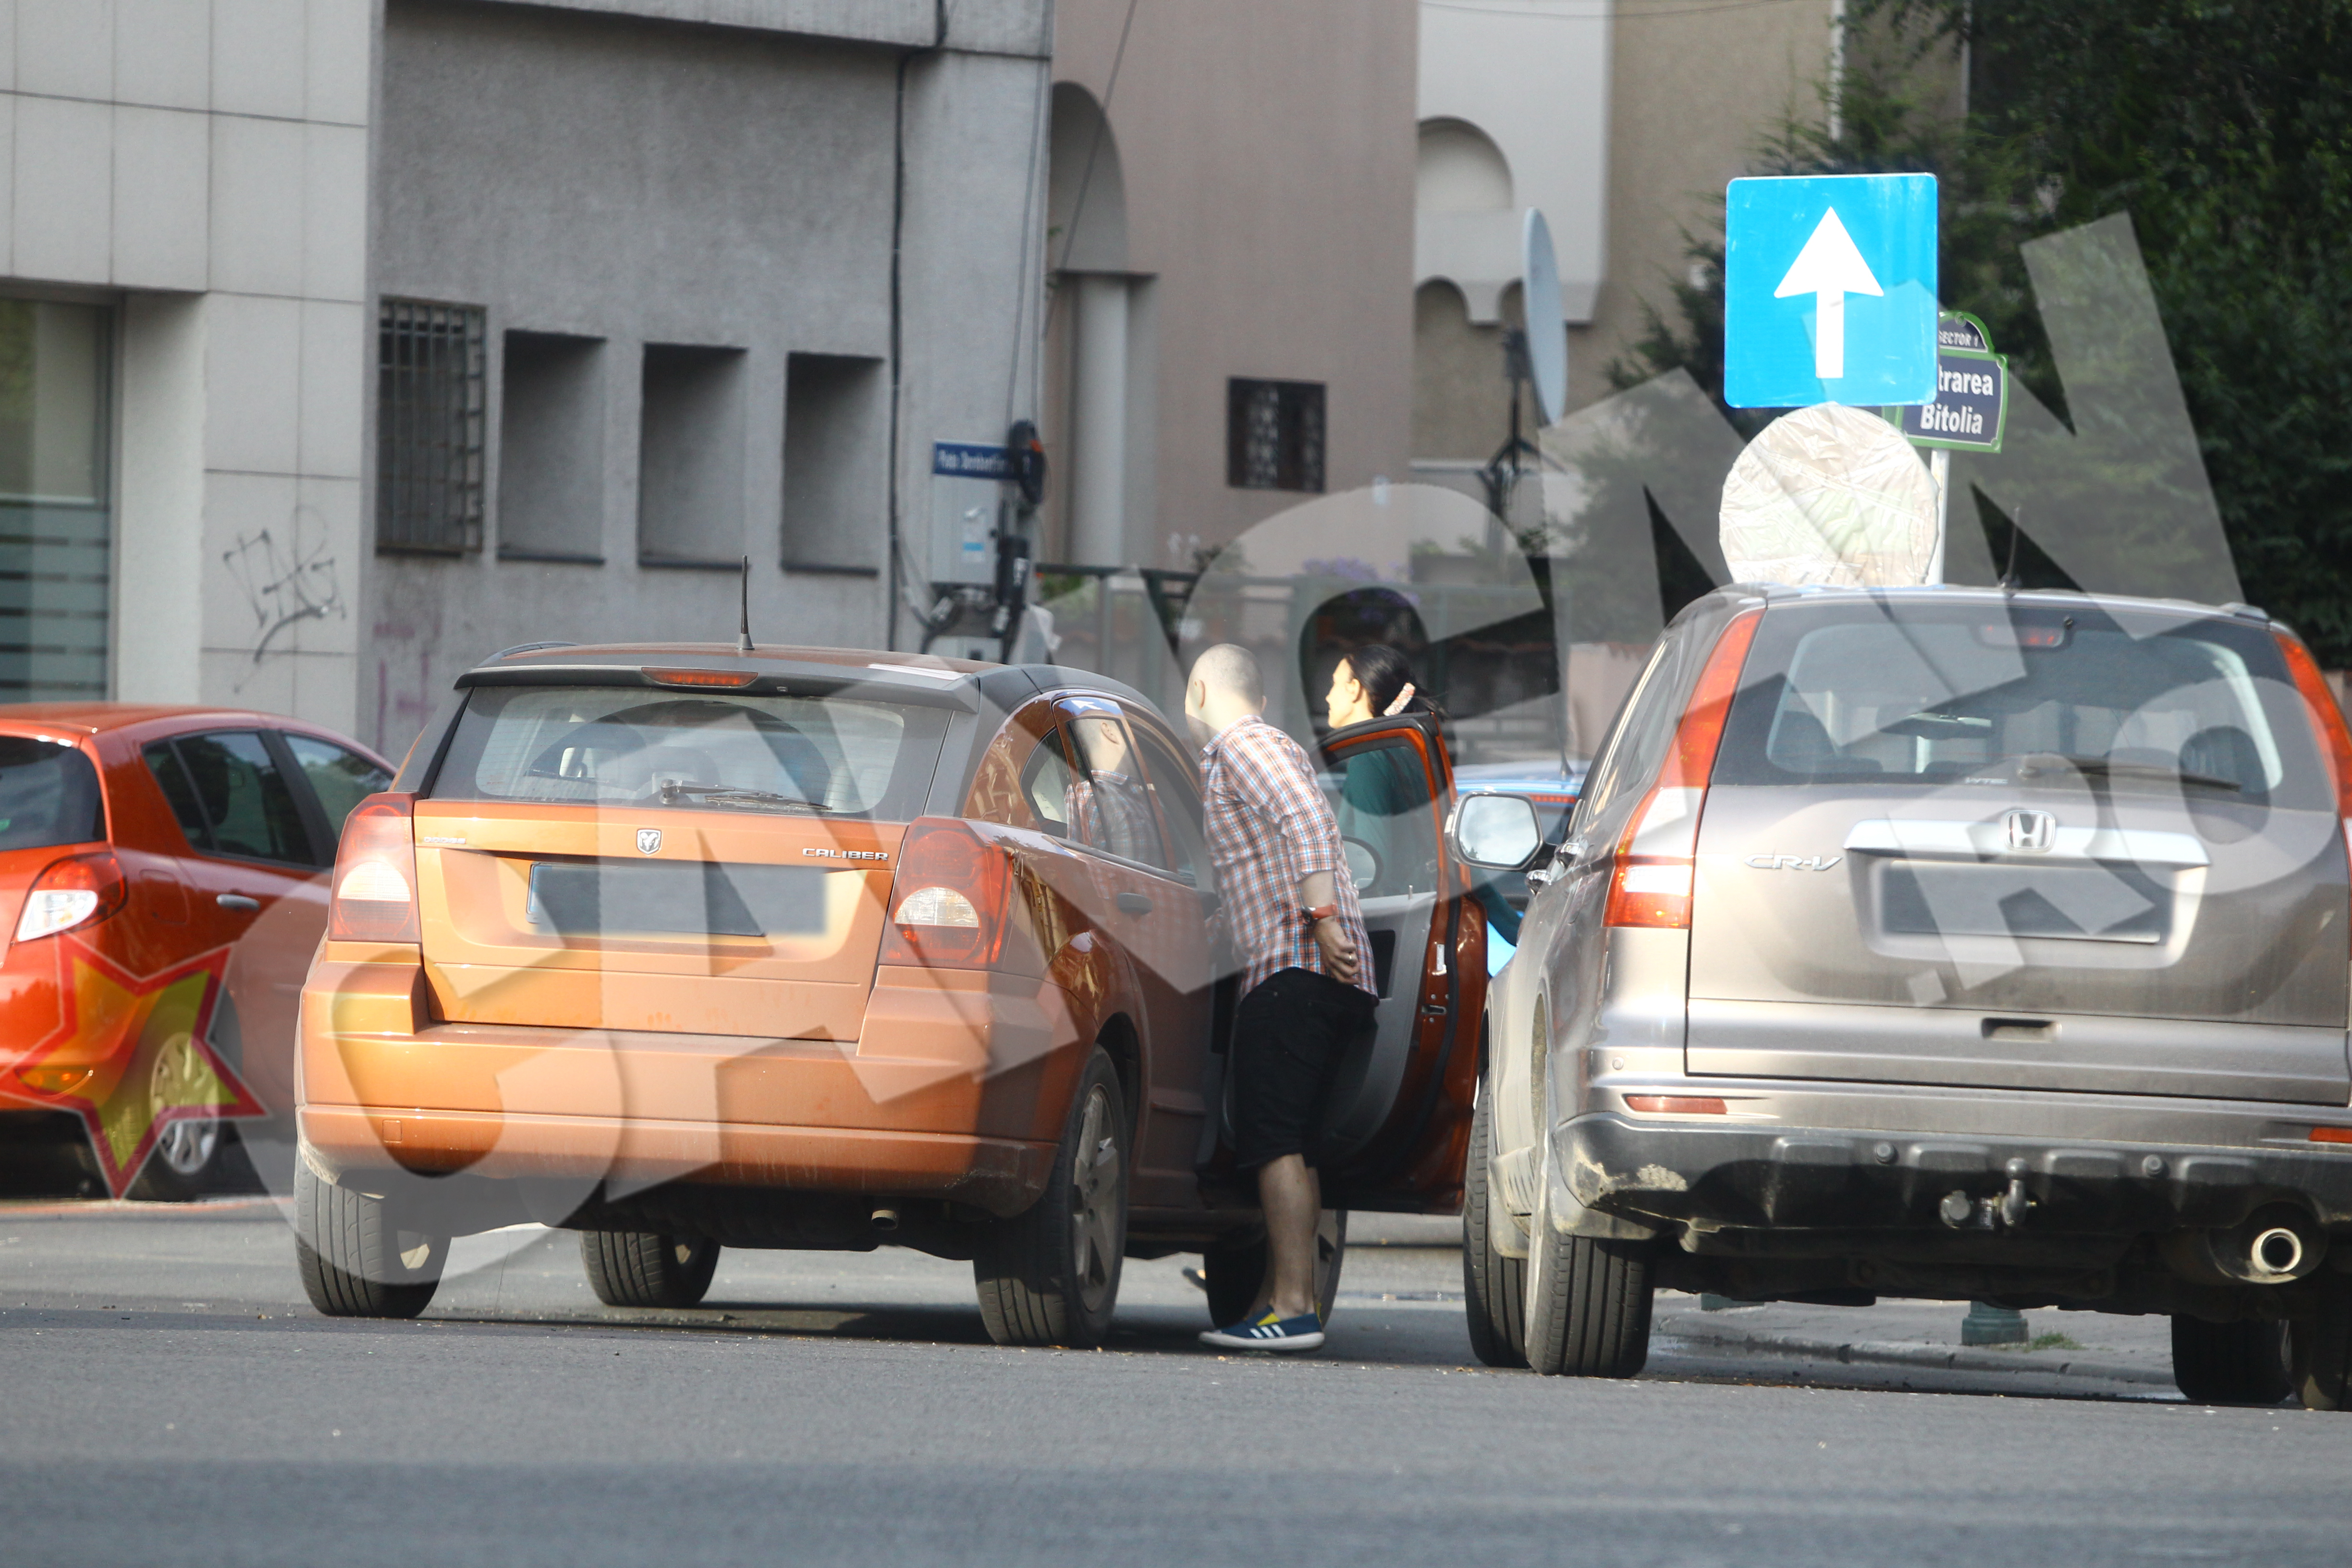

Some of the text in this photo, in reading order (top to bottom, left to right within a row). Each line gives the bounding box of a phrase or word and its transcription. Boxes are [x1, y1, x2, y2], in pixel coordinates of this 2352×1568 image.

[1938, 363, 1994, 396] trarea
[1920, 403, 1984, 434] Bitolia
[802, 848, 888, 861] CALIBER
[1744, 853, 1844, 871] CR-V
